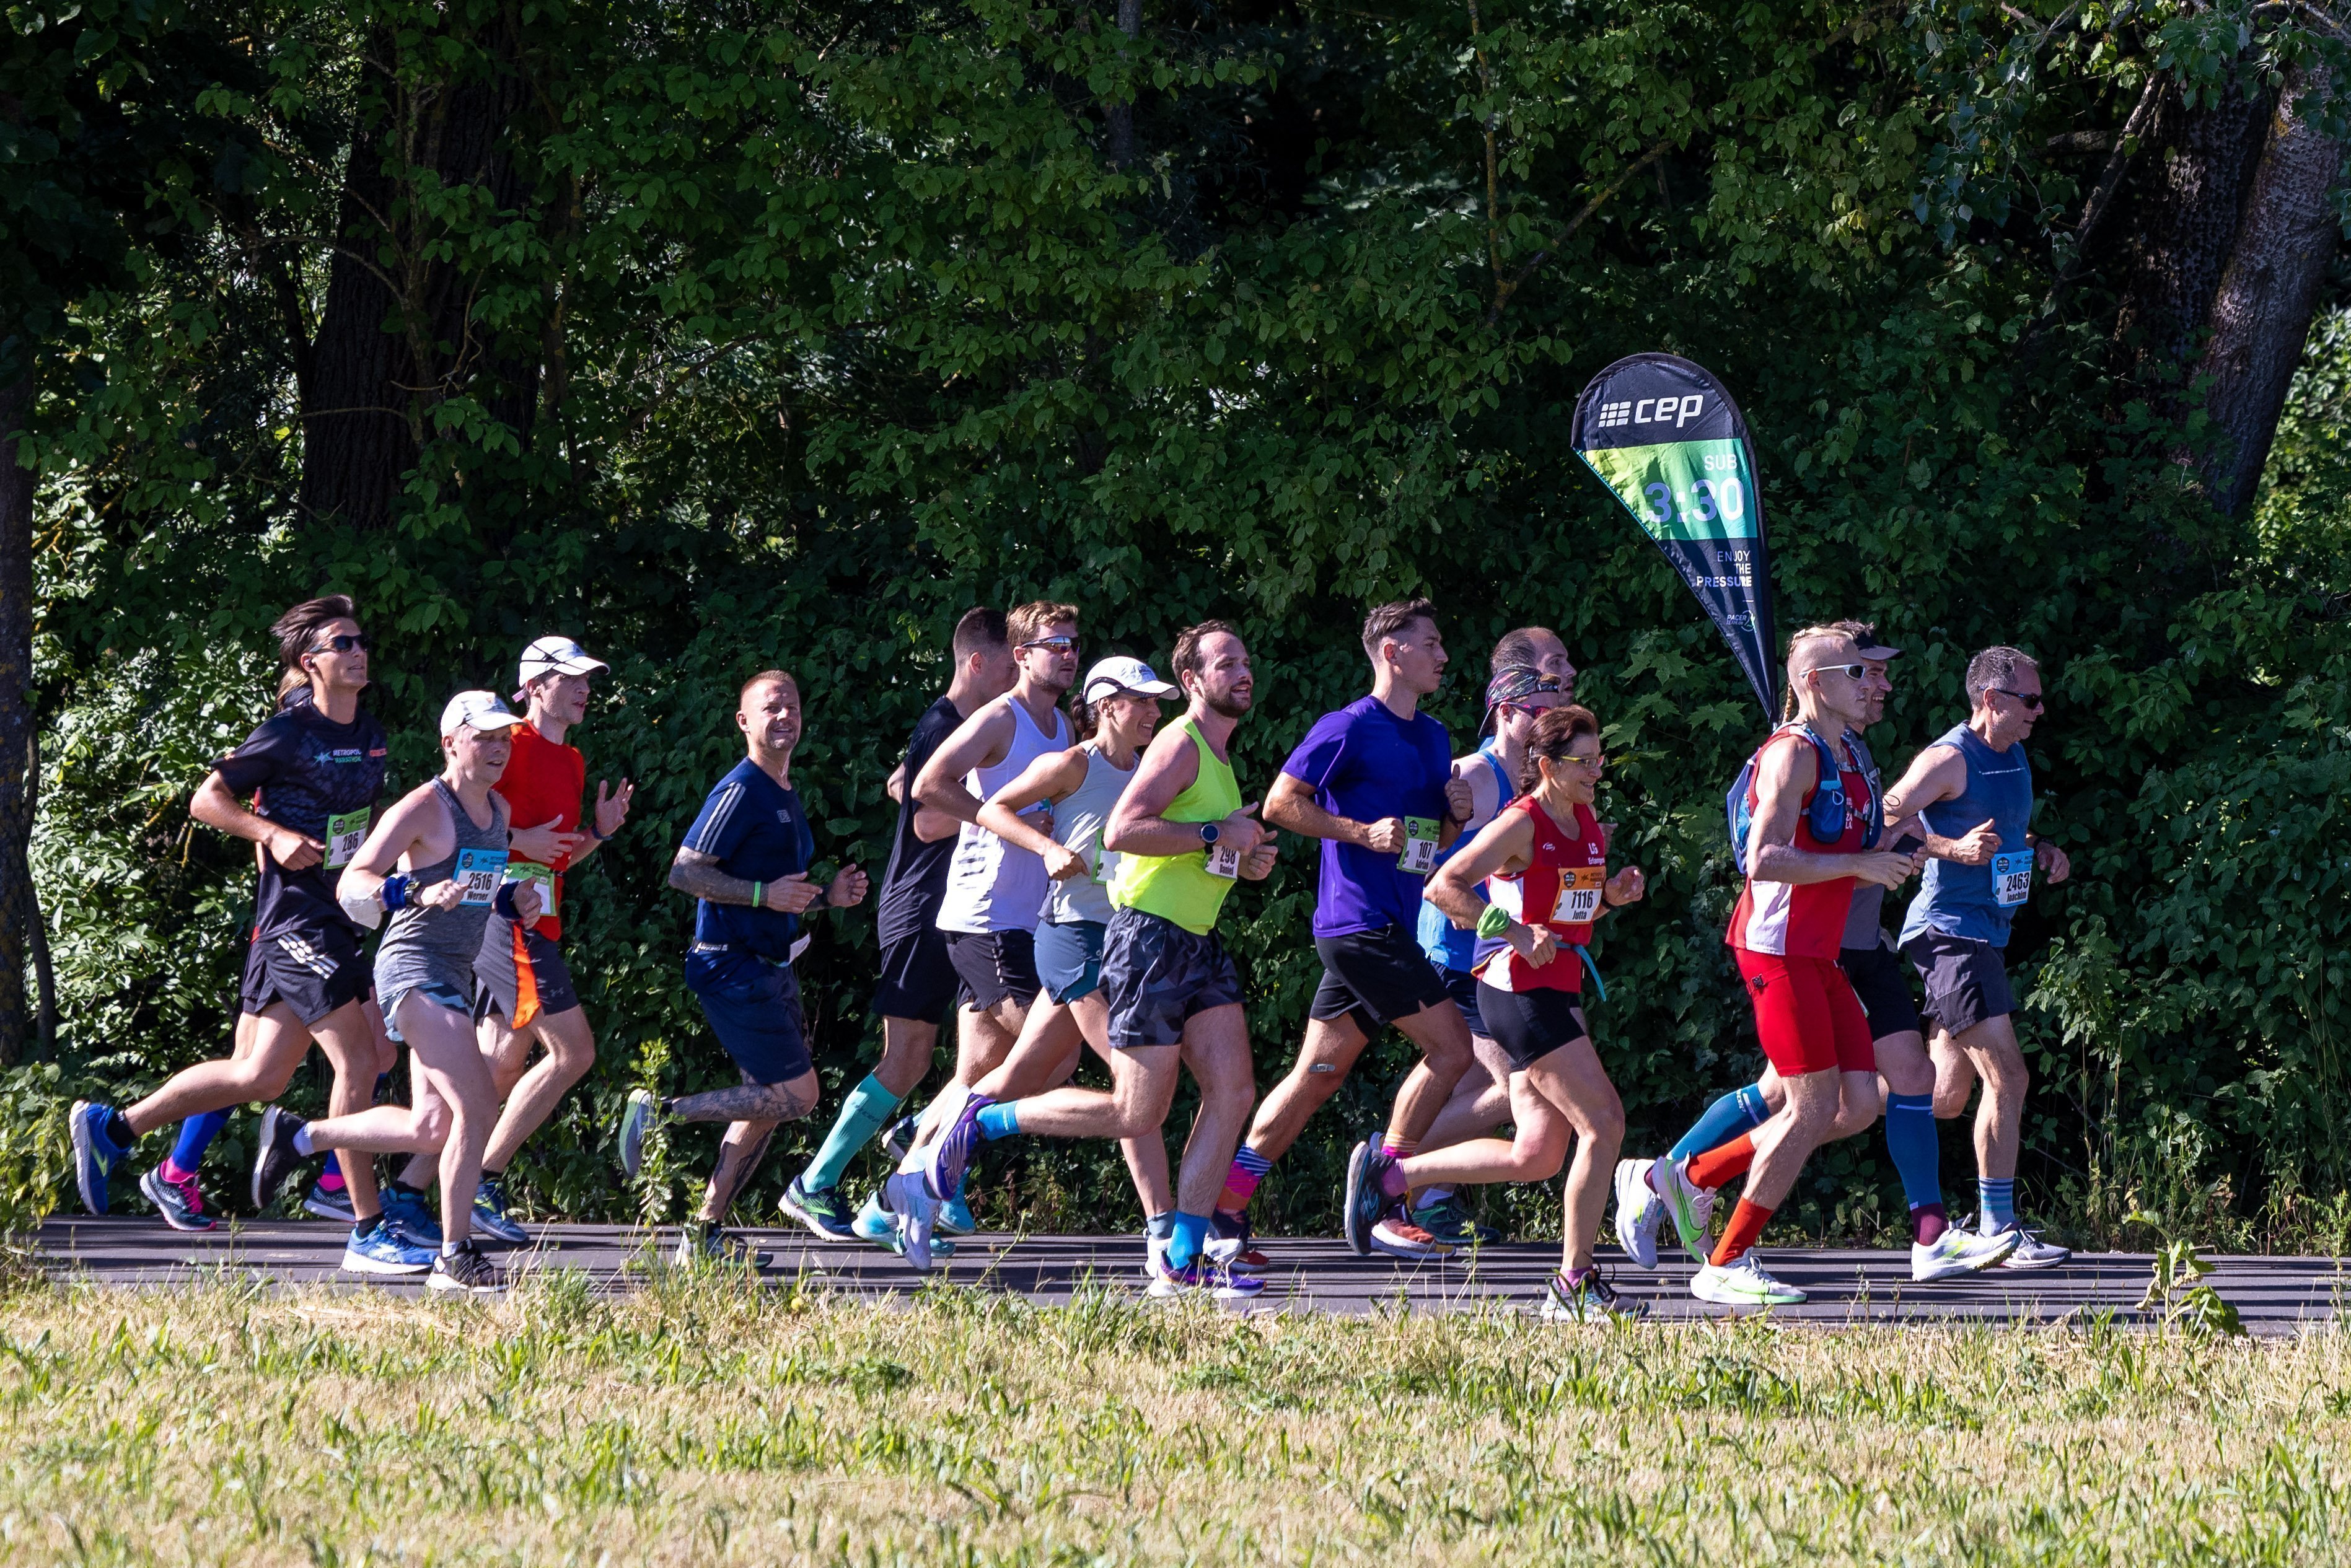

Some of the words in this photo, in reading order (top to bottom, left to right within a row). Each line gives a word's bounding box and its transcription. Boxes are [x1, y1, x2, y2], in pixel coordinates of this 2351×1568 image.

[1635, 395, 1703, 428] cep
[1704, 454, 1737, 471] SUB
[1644, 477, 1744, 523] 3:30
[1717, 550, 1751, 562] ENJOY
[1734, 563, 1751, 574] THE
[1696, 576, 1752, 587] PRESSURE
[342, 832, 359, 852] 286
[1588, 843, 1598, 854] LG
[1220, 846, 1237, 865] 298
[1419, 841, 1433, 859] 107
[1219, 864, 1234, 876] Daniel
[1415, 859, 1429, 870] Adrian
[468, 872, 493, 890] 2516
[2006, 872, 2029, 892] 2463
[467, 891, 489, 901] Werner
[1571, 891, 1593, 909] 7116
[2006, 891, 2027, 903] Joachim
[1572, 910, 1587, 920] Jutta
